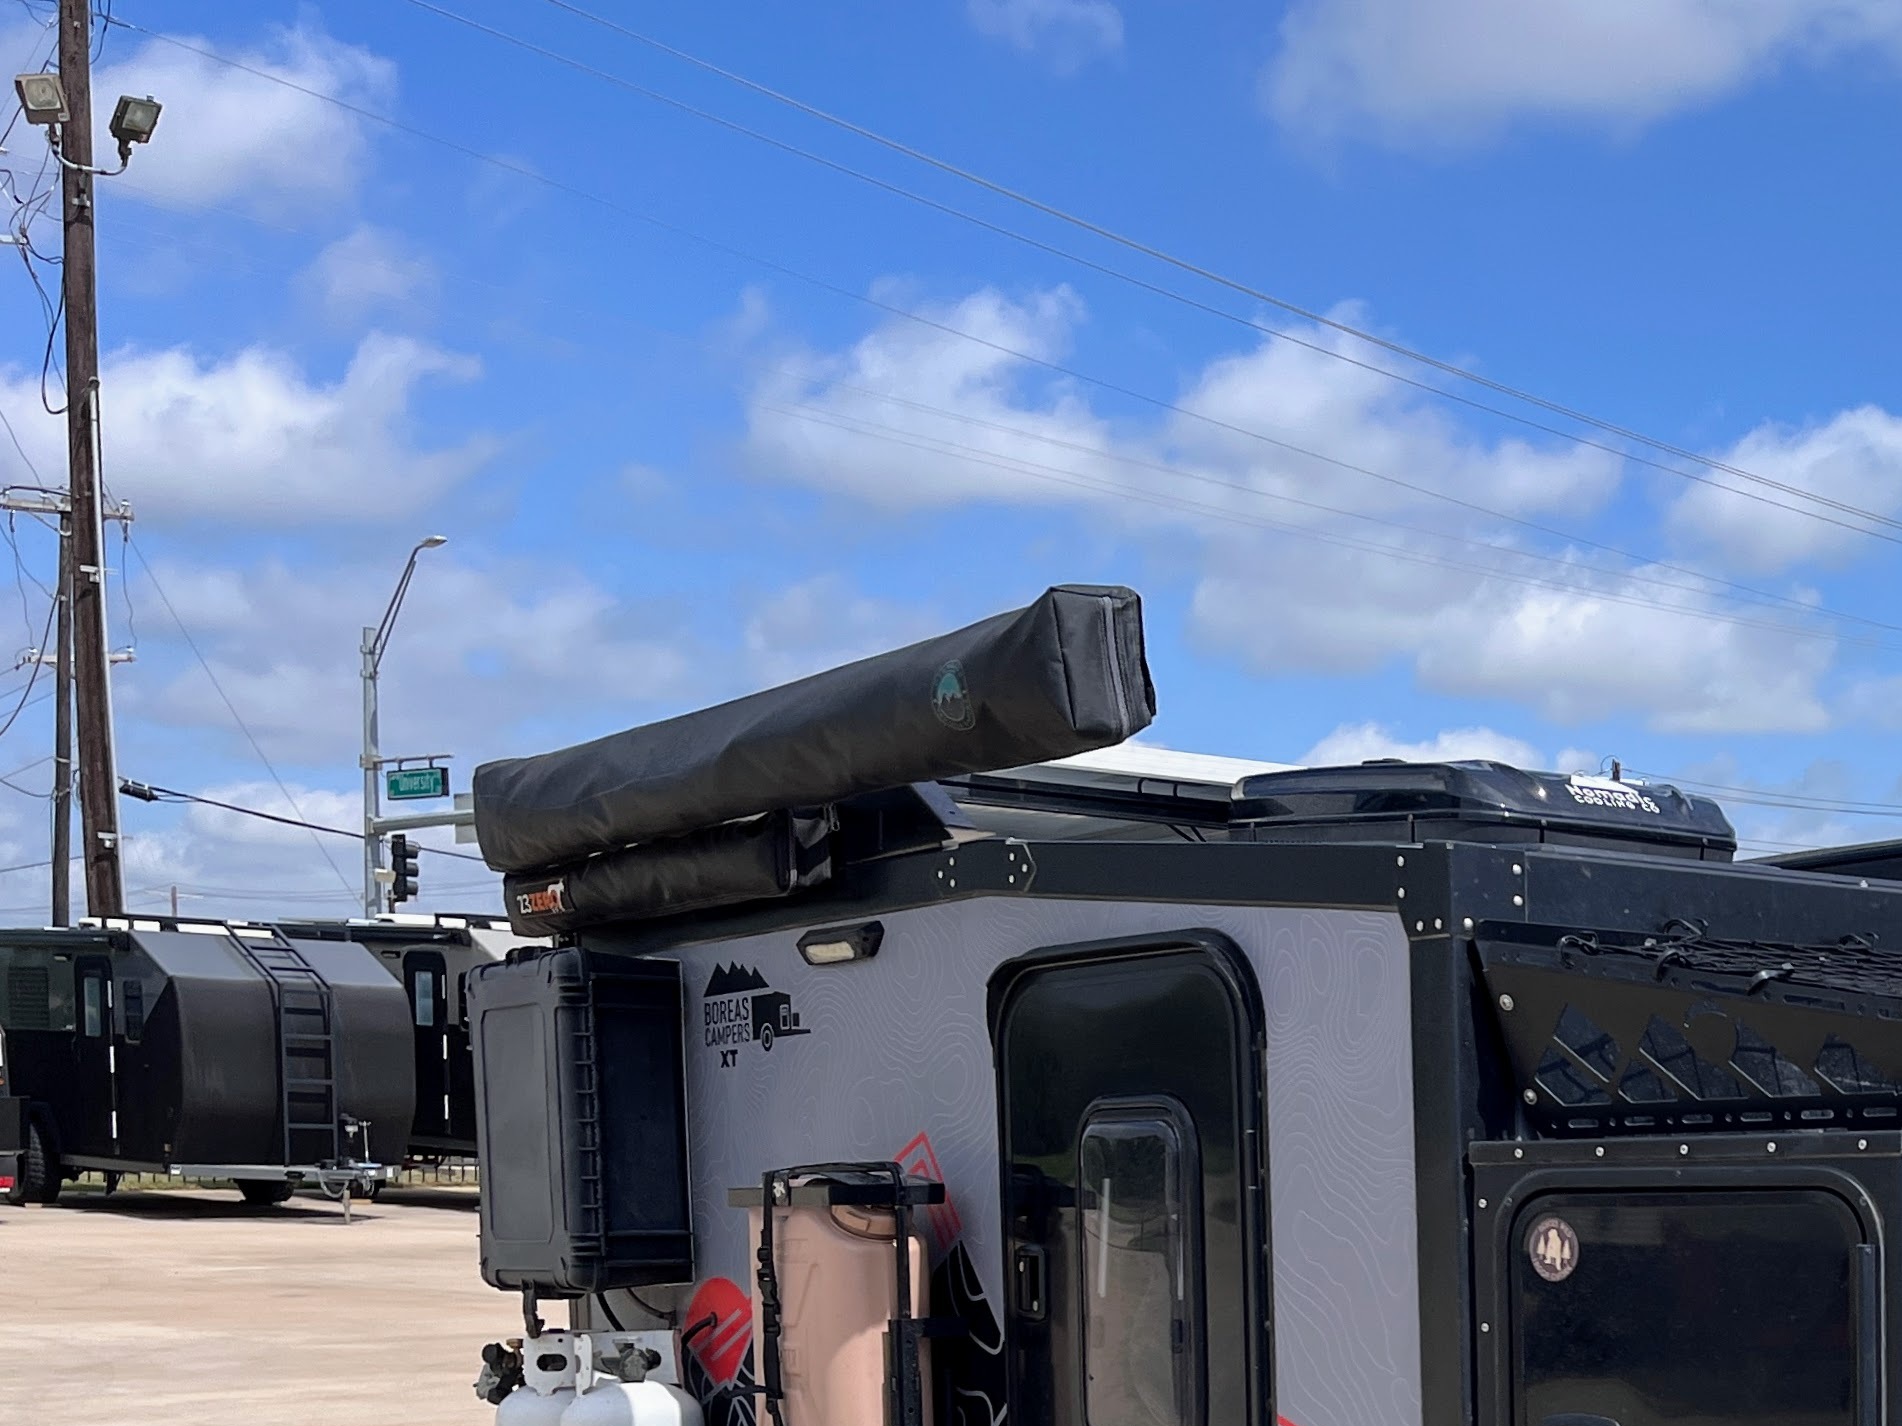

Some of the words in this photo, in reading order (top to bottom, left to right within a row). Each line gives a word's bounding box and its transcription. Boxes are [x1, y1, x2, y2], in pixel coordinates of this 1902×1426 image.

[398, 774, 434, 793] University
[1573, 795, 1636, 810] COOLING
[704, 997, 750, 1026] BOREAS
[705, 1022, 750, 1048] CAMPERS
[720, 1049, 738, 1068] XT
